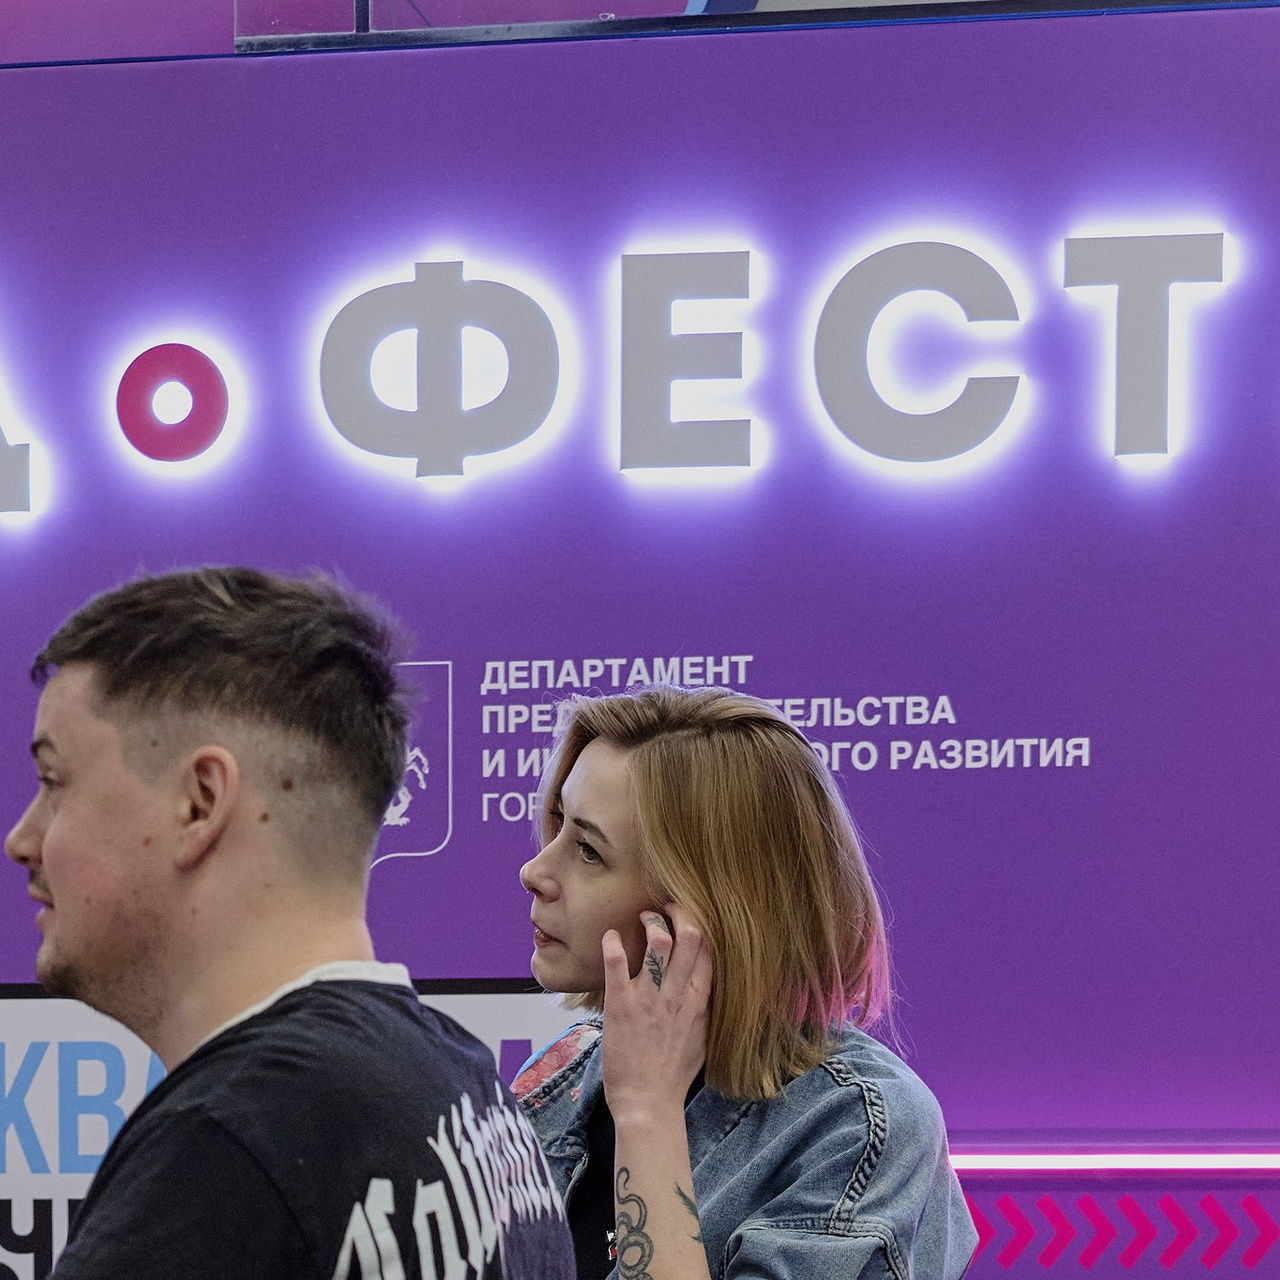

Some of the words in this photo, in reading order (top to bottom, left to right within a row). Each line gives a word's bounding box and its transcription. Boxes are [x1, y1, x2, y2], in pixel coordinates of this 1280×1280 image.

[319, 232, 1224, 479] ФЕСТ
[480, 655, 754, 695] ДЕПАРТАМЕНТ
[890, 737, 1090, 770] РАЗВИТИЯ
